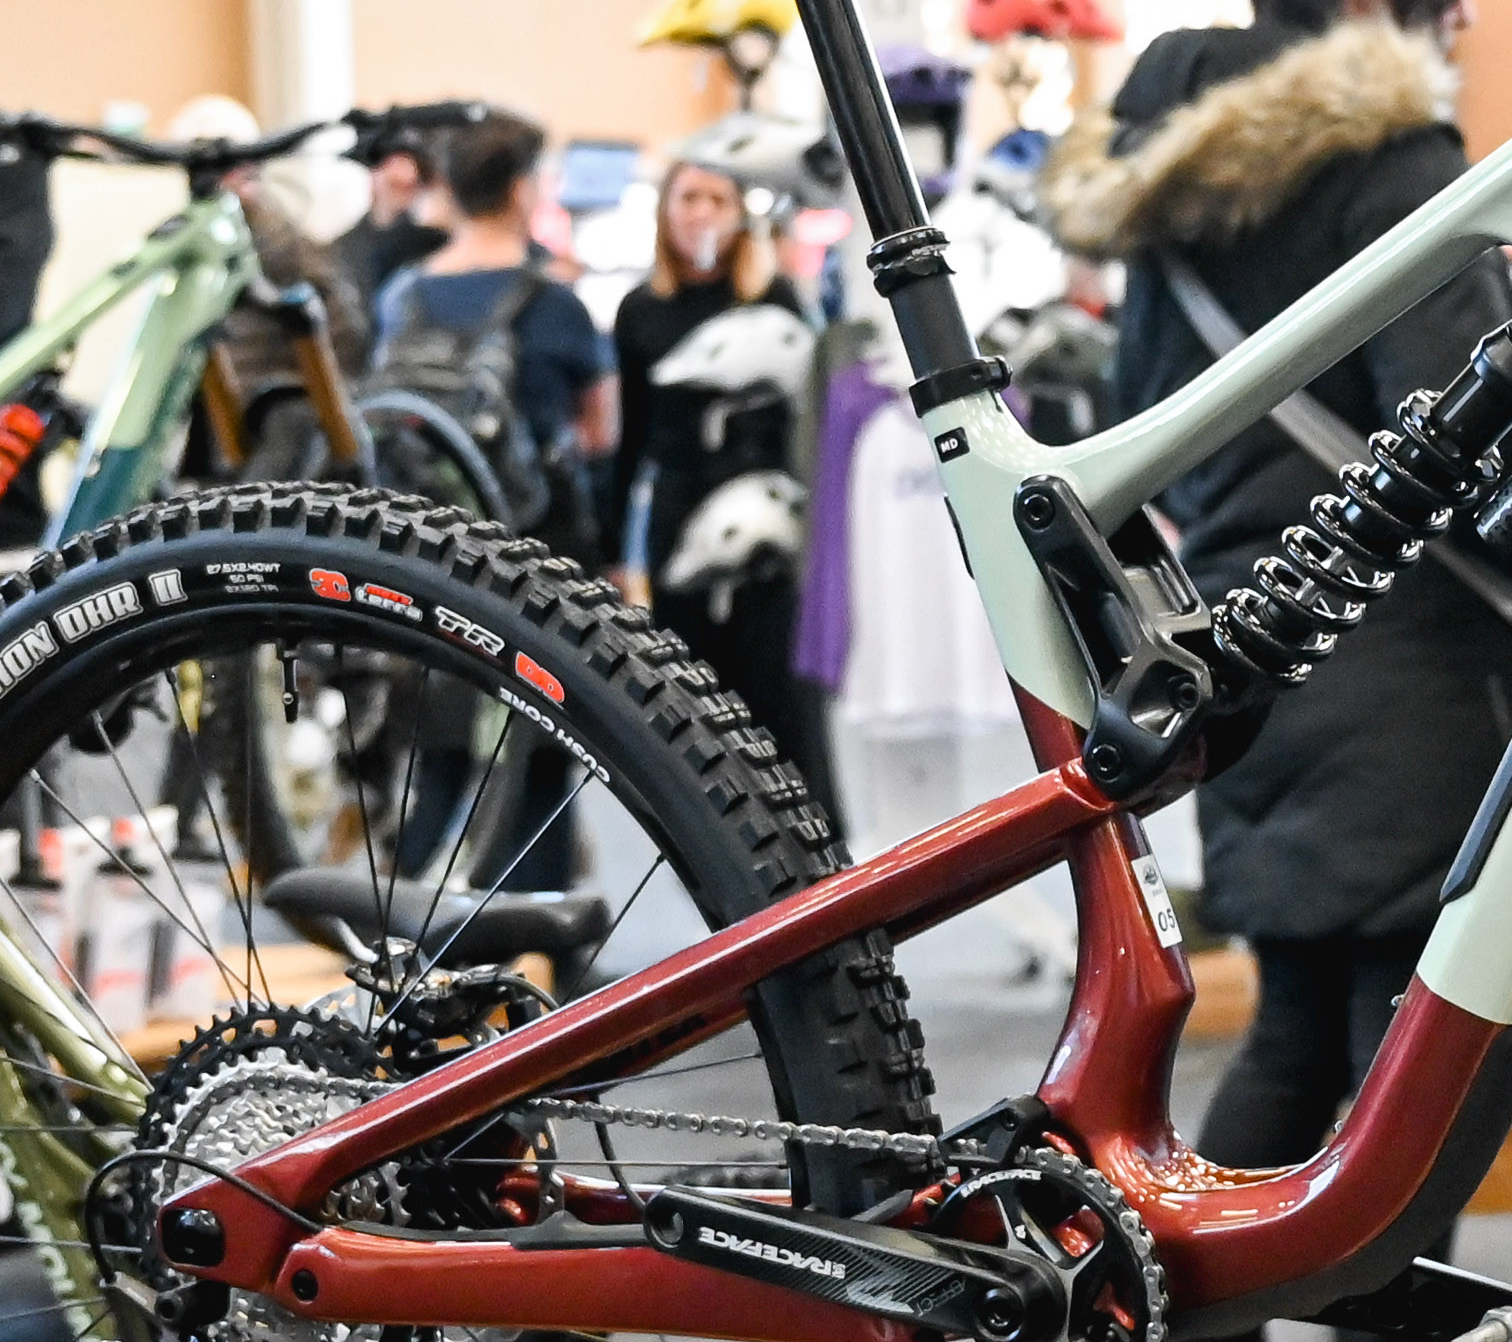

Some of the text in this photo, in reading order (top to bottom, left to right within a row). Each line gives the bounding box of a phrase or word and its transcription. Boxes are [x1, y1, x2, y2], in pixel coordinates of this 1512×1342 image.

[53, 580, 144, 644] DHR
[499, 686, 611, 783] CUSH CORE
[698, 1225, 835, 1278] RACEFACE
